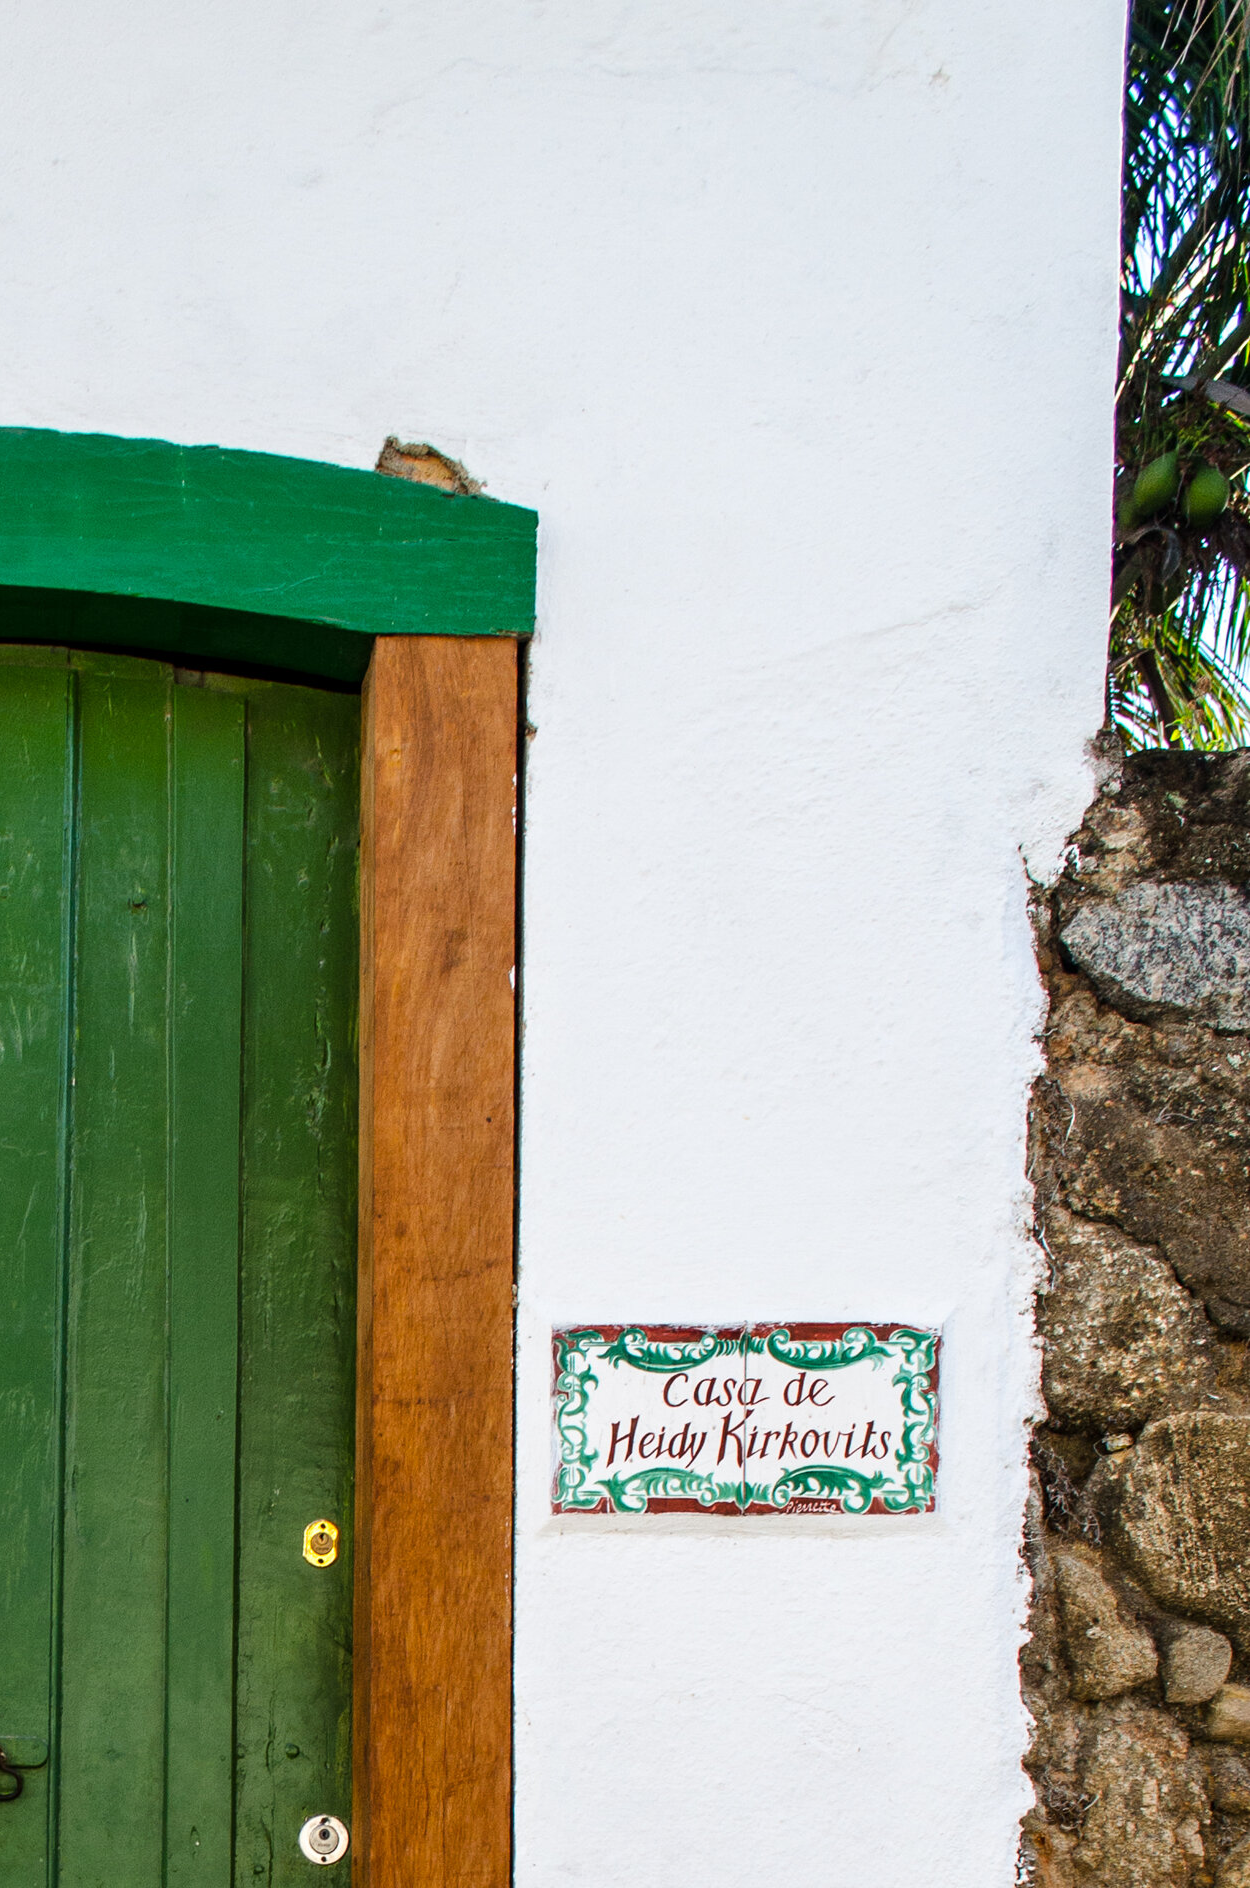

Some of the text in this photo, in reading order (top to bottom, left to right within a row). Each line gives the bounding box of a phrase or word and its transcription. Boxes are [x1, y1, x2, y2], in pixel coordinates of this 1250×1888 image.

[663, 1372, 835, 1407] Casa de
[606, 1409, 892, 1469] Heidy Kirkovits
